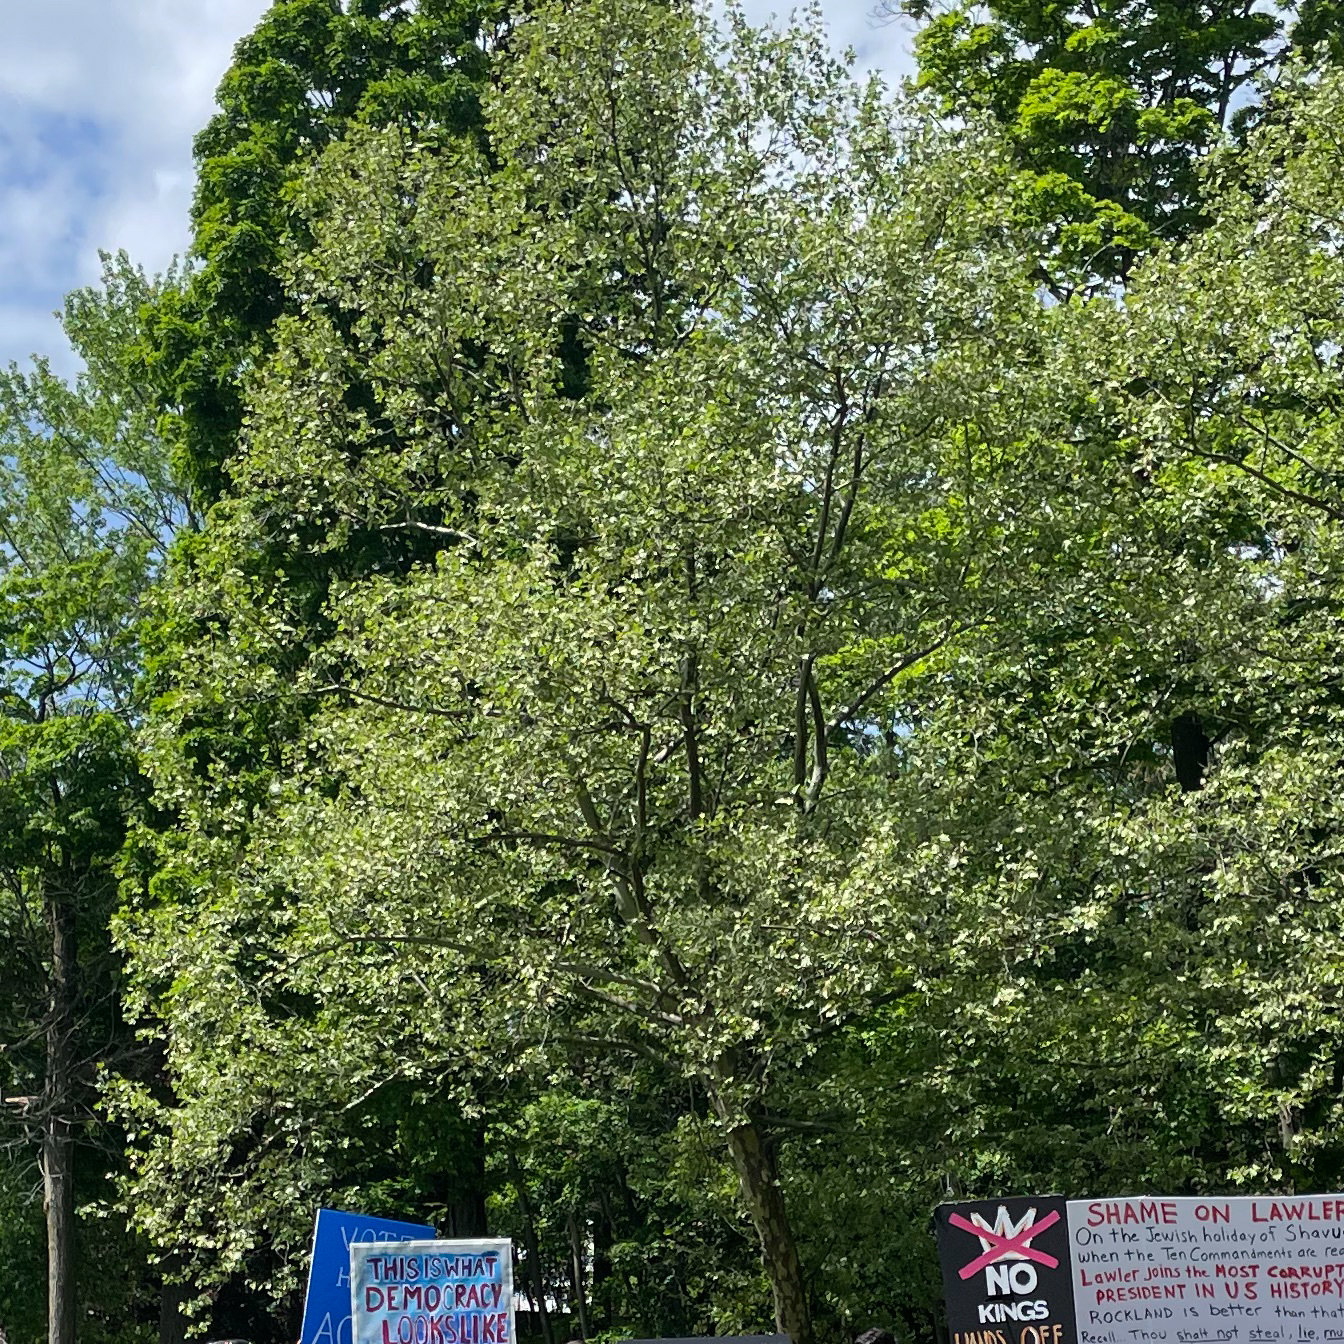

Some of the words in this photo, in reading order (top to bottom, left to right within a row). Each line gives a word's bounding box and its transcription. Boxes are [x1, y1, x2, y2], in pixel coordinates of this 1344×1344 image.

[1087, 1202, 1177, 1226] SHAME
[1195, 1204, 1229, 1223] ON
[1076, 1227, 1103, 1246] On
[1109, 1227, 1139, 1243] the
[1146, 1226, 1197, 1243] Jewish
[1203, 1226, 1255, 1245] holiday
[1260, 1225, 1276, 1242] of
[1078, 1249, 1119, 1263] when
[1124, 1249, 1155, 1261] the
[1161, 1247, 1189, 1261] Ten
[1190, 1246, 1292, 1261] Commandments
[1298, 1248, 1317, 1257] are
[367, 1257, 419, 1281] THIS
[424, 1257, 442, 1279] IS
[444, 1256, 497, 1279] WHAT
[985, 1262, 1038, 1297] NO
[1080, 1268, 1139, 1287] Lawler
[1186, 1265, 1210, 1279] the
[1216, 1264, 1260, 1278] MOST
[365, 1283, 503, 1313] DEMOCRACY
[1096, 1284, 1186, 1305] PRESIDENT
[1195, 1283, 1215, 1298] IN
[1225, 1281, 1258, 1300] US
[978, 1300, 1050, 1324] KINGS
[1090, 1307, 1173, 1324] ROCKLAND
[1209, 1303, 1262, 1317] better
[1275, 1305, 1305, 1318] than
[460, 1312, 508, 1344] LIKE
[1128, 1329, 1167, 1341] Thou
[1176, 1327, 1208, 1341] shalt
[1217, 1325, 1238, 1339] not
